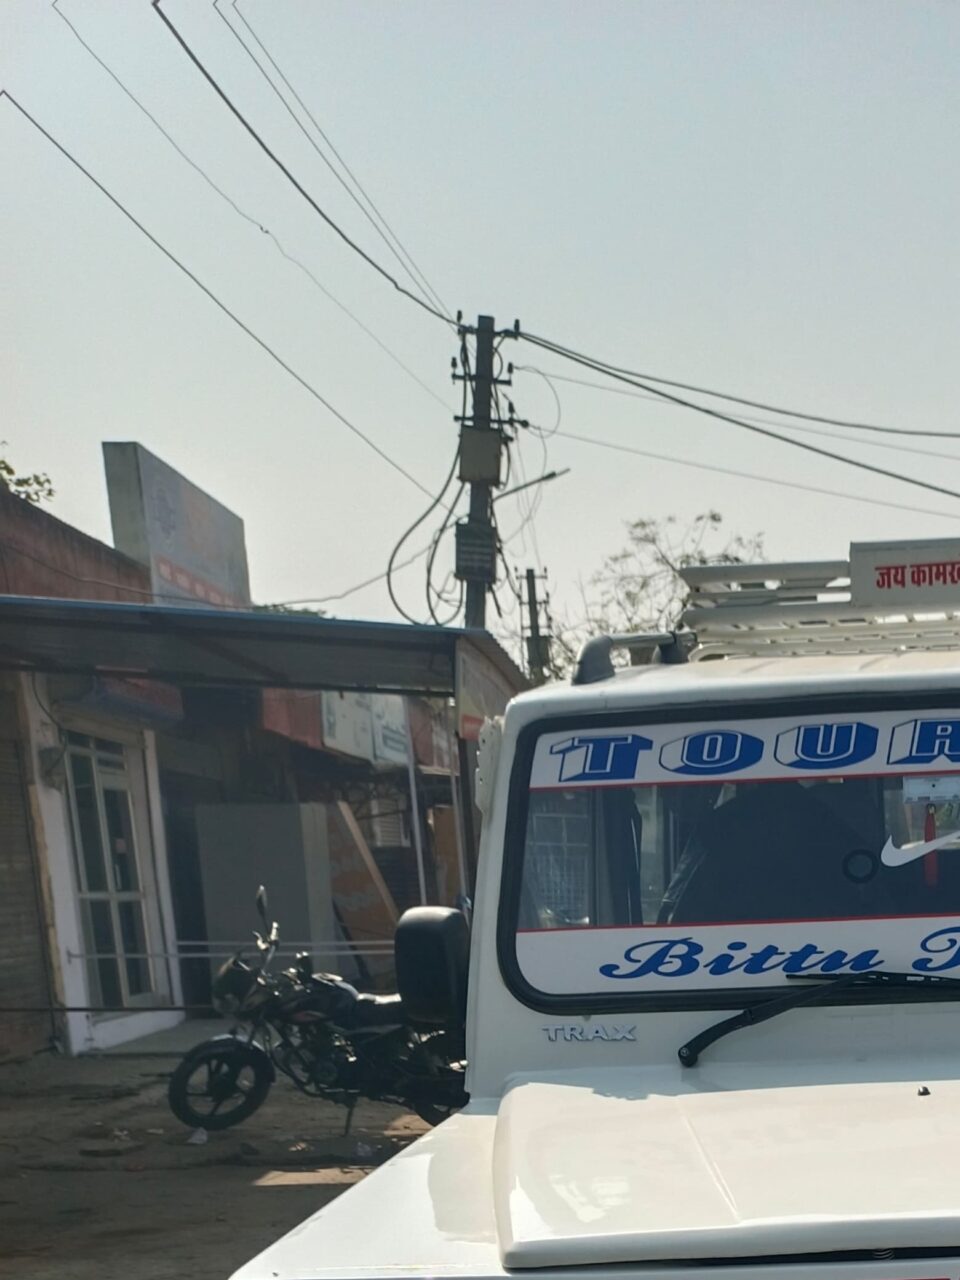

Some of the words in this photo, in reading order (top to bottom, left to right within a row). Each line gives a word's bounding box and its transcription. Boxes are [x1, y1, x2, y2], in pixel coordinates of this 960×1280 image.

[875, 564, 907, 589] जय
[599, 936, 885, 979] Bittu
[541, 1023, 637, 1042] TRAX
